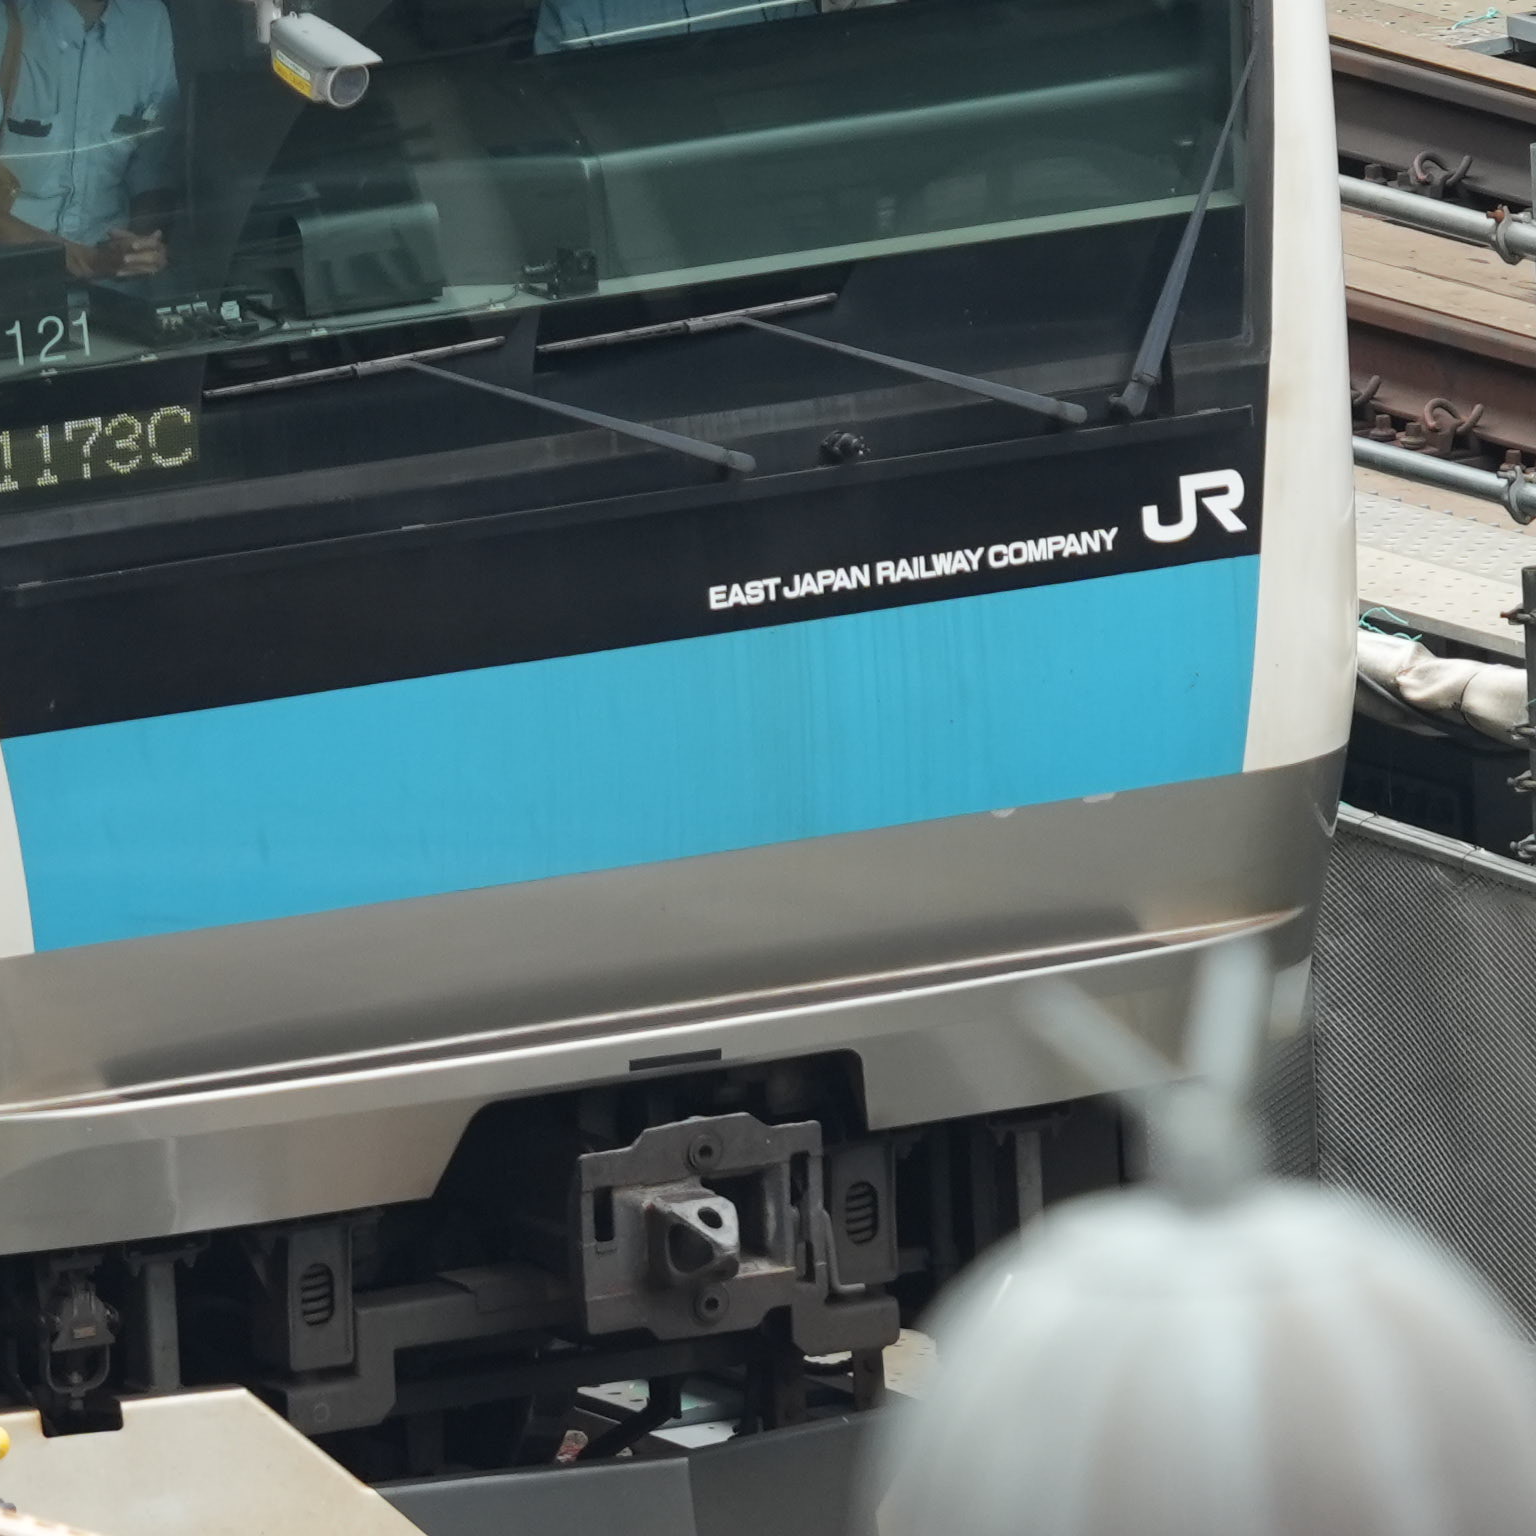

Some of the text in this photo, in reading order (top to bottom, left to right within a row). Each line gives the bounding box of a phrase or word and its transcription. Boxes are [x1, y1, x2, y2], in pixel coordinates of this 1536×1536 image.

[5, 310, 91, 365] 121
[1142, 468, 1247, 543] JR
[709, 527, 1118, 610] EAST JAPAN RAILWAY COMPANY
